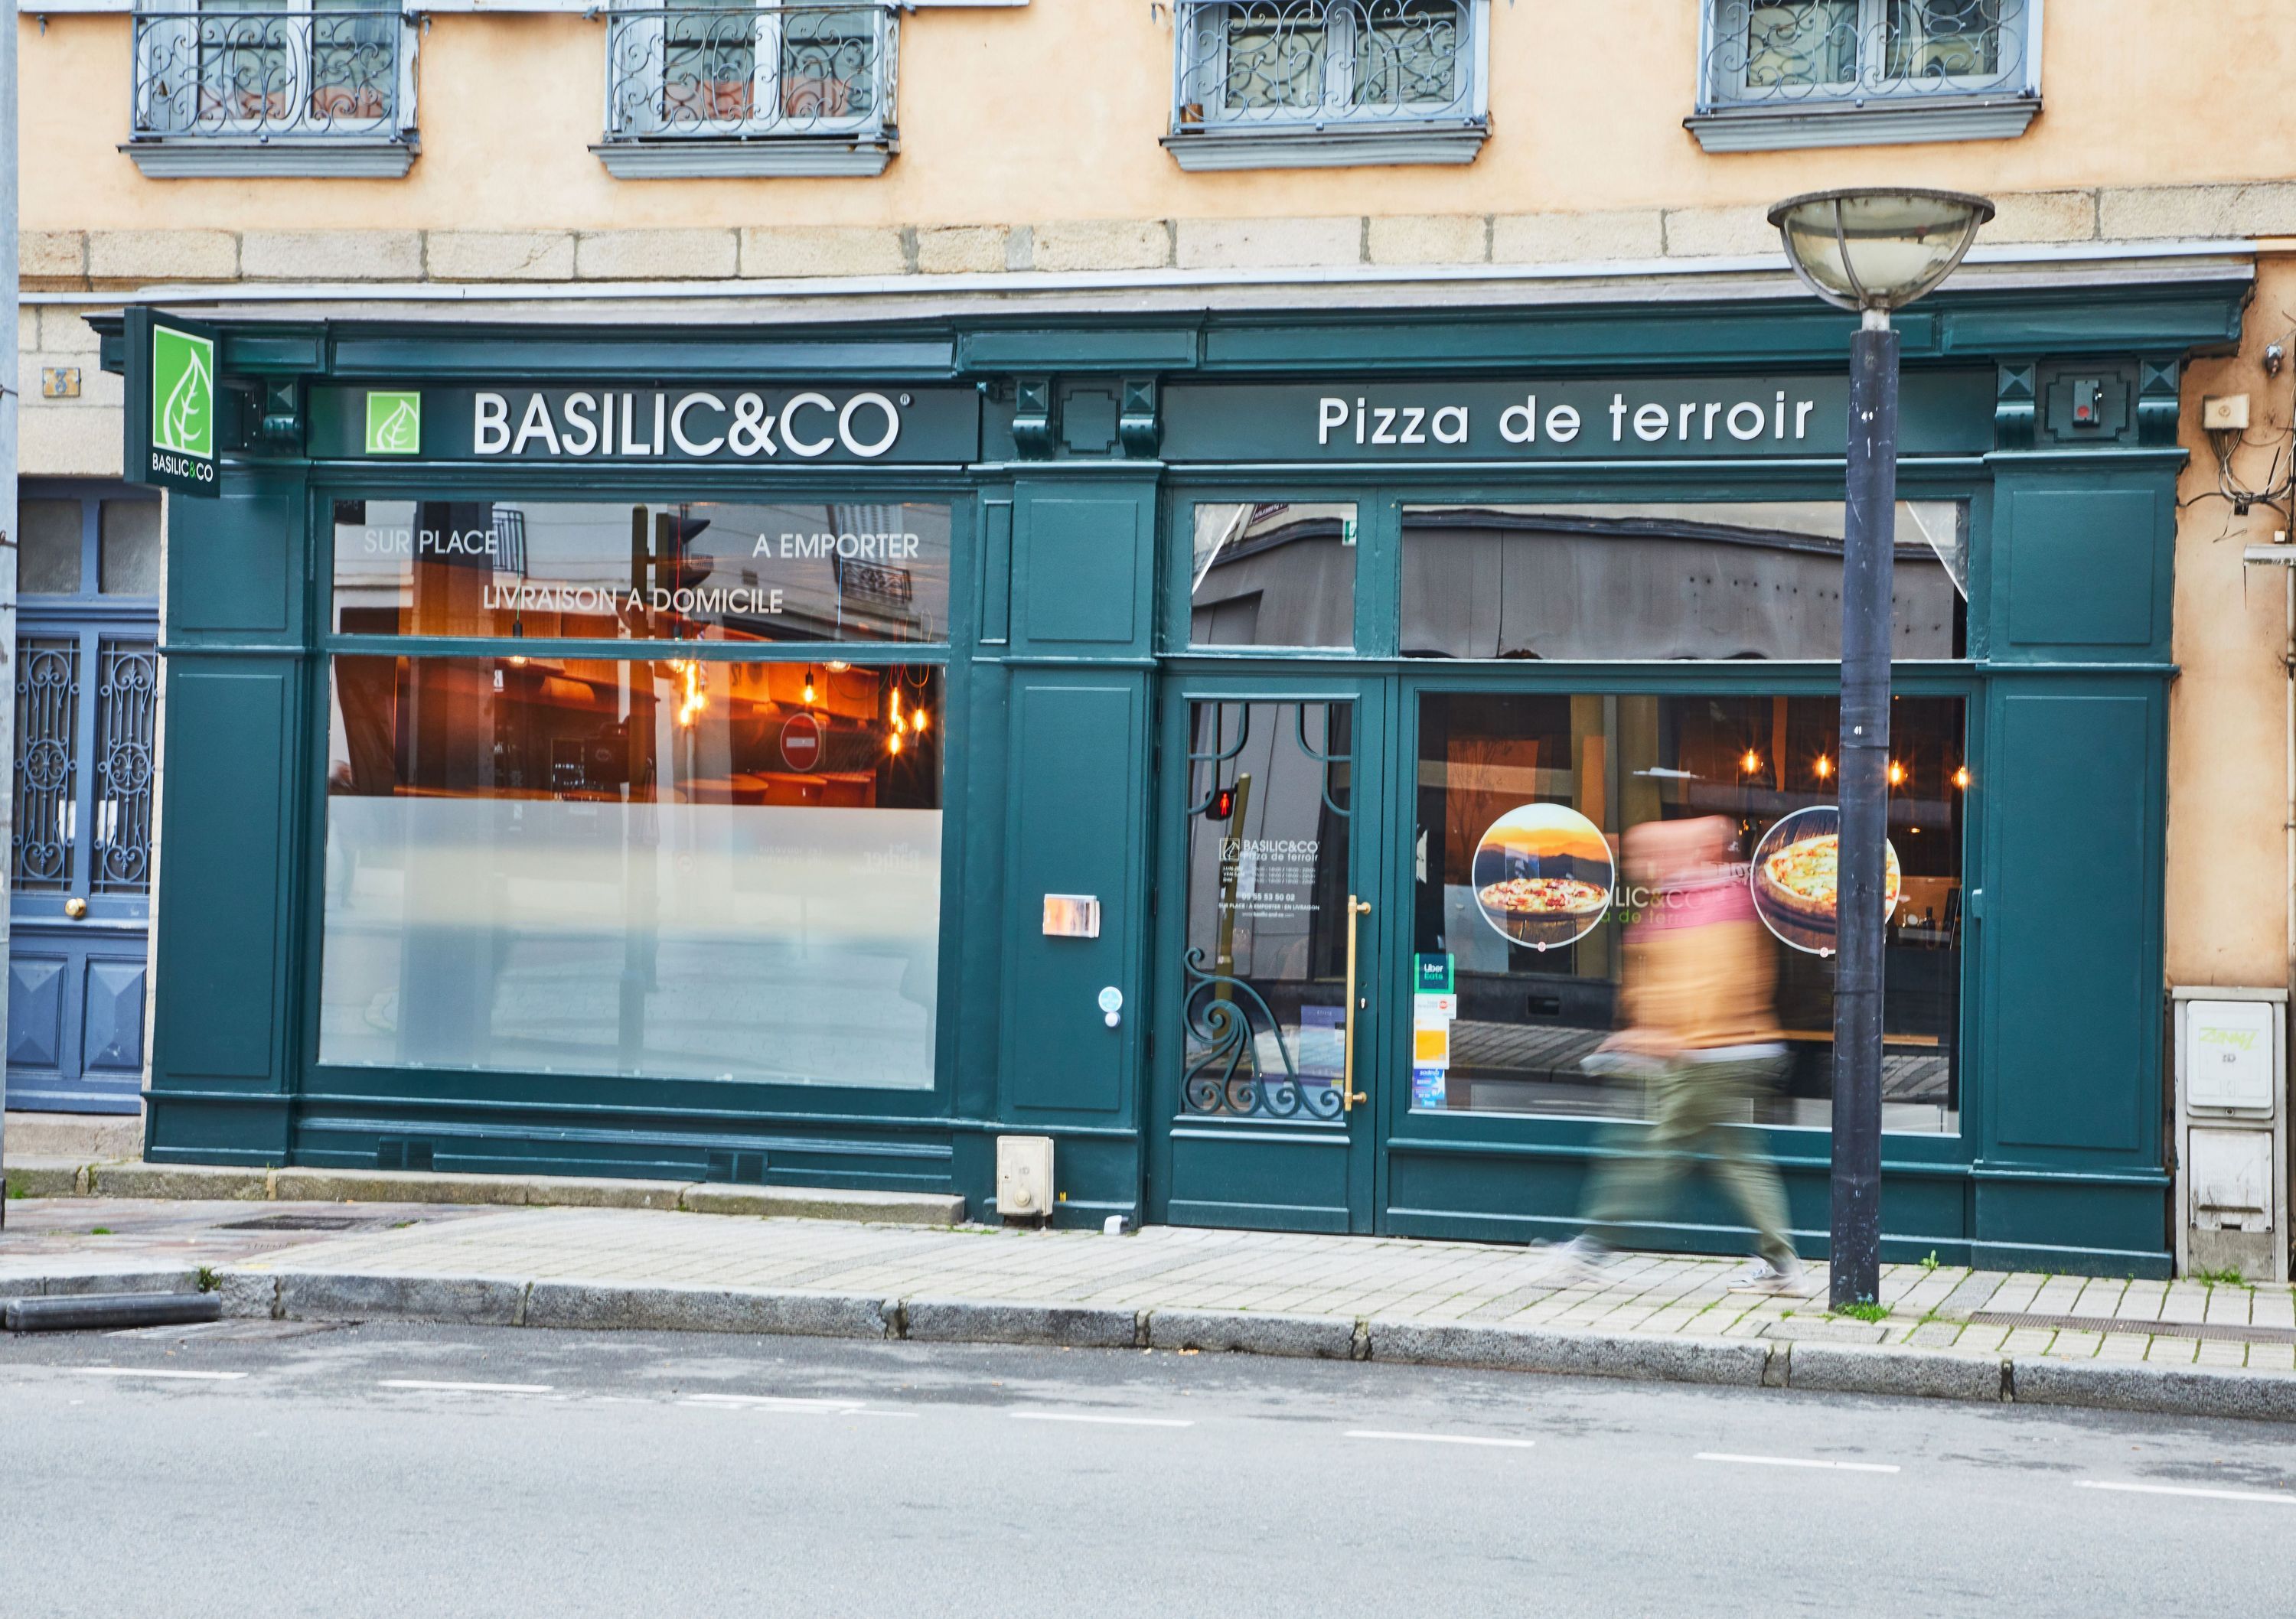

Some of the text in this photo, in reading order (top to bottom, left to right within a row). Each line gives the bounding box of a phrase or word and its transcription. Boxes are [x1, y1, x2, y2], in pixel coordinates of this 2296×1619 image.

[54, 367, 67, 393] 3
[1318, 390, 1814, 445] Pizza de terroir
[152, 452, 214, 482] BASILIC&CO
[364, 529, 498, 555] SUR PLACE
[752, 533, 919, 559] A EMPORTER
[482, 584, 783, 614] LIVRAISON A DOMICILE
[1270, 852, 1284, 862] de
[1424, 963, 1444, 973] Uber
